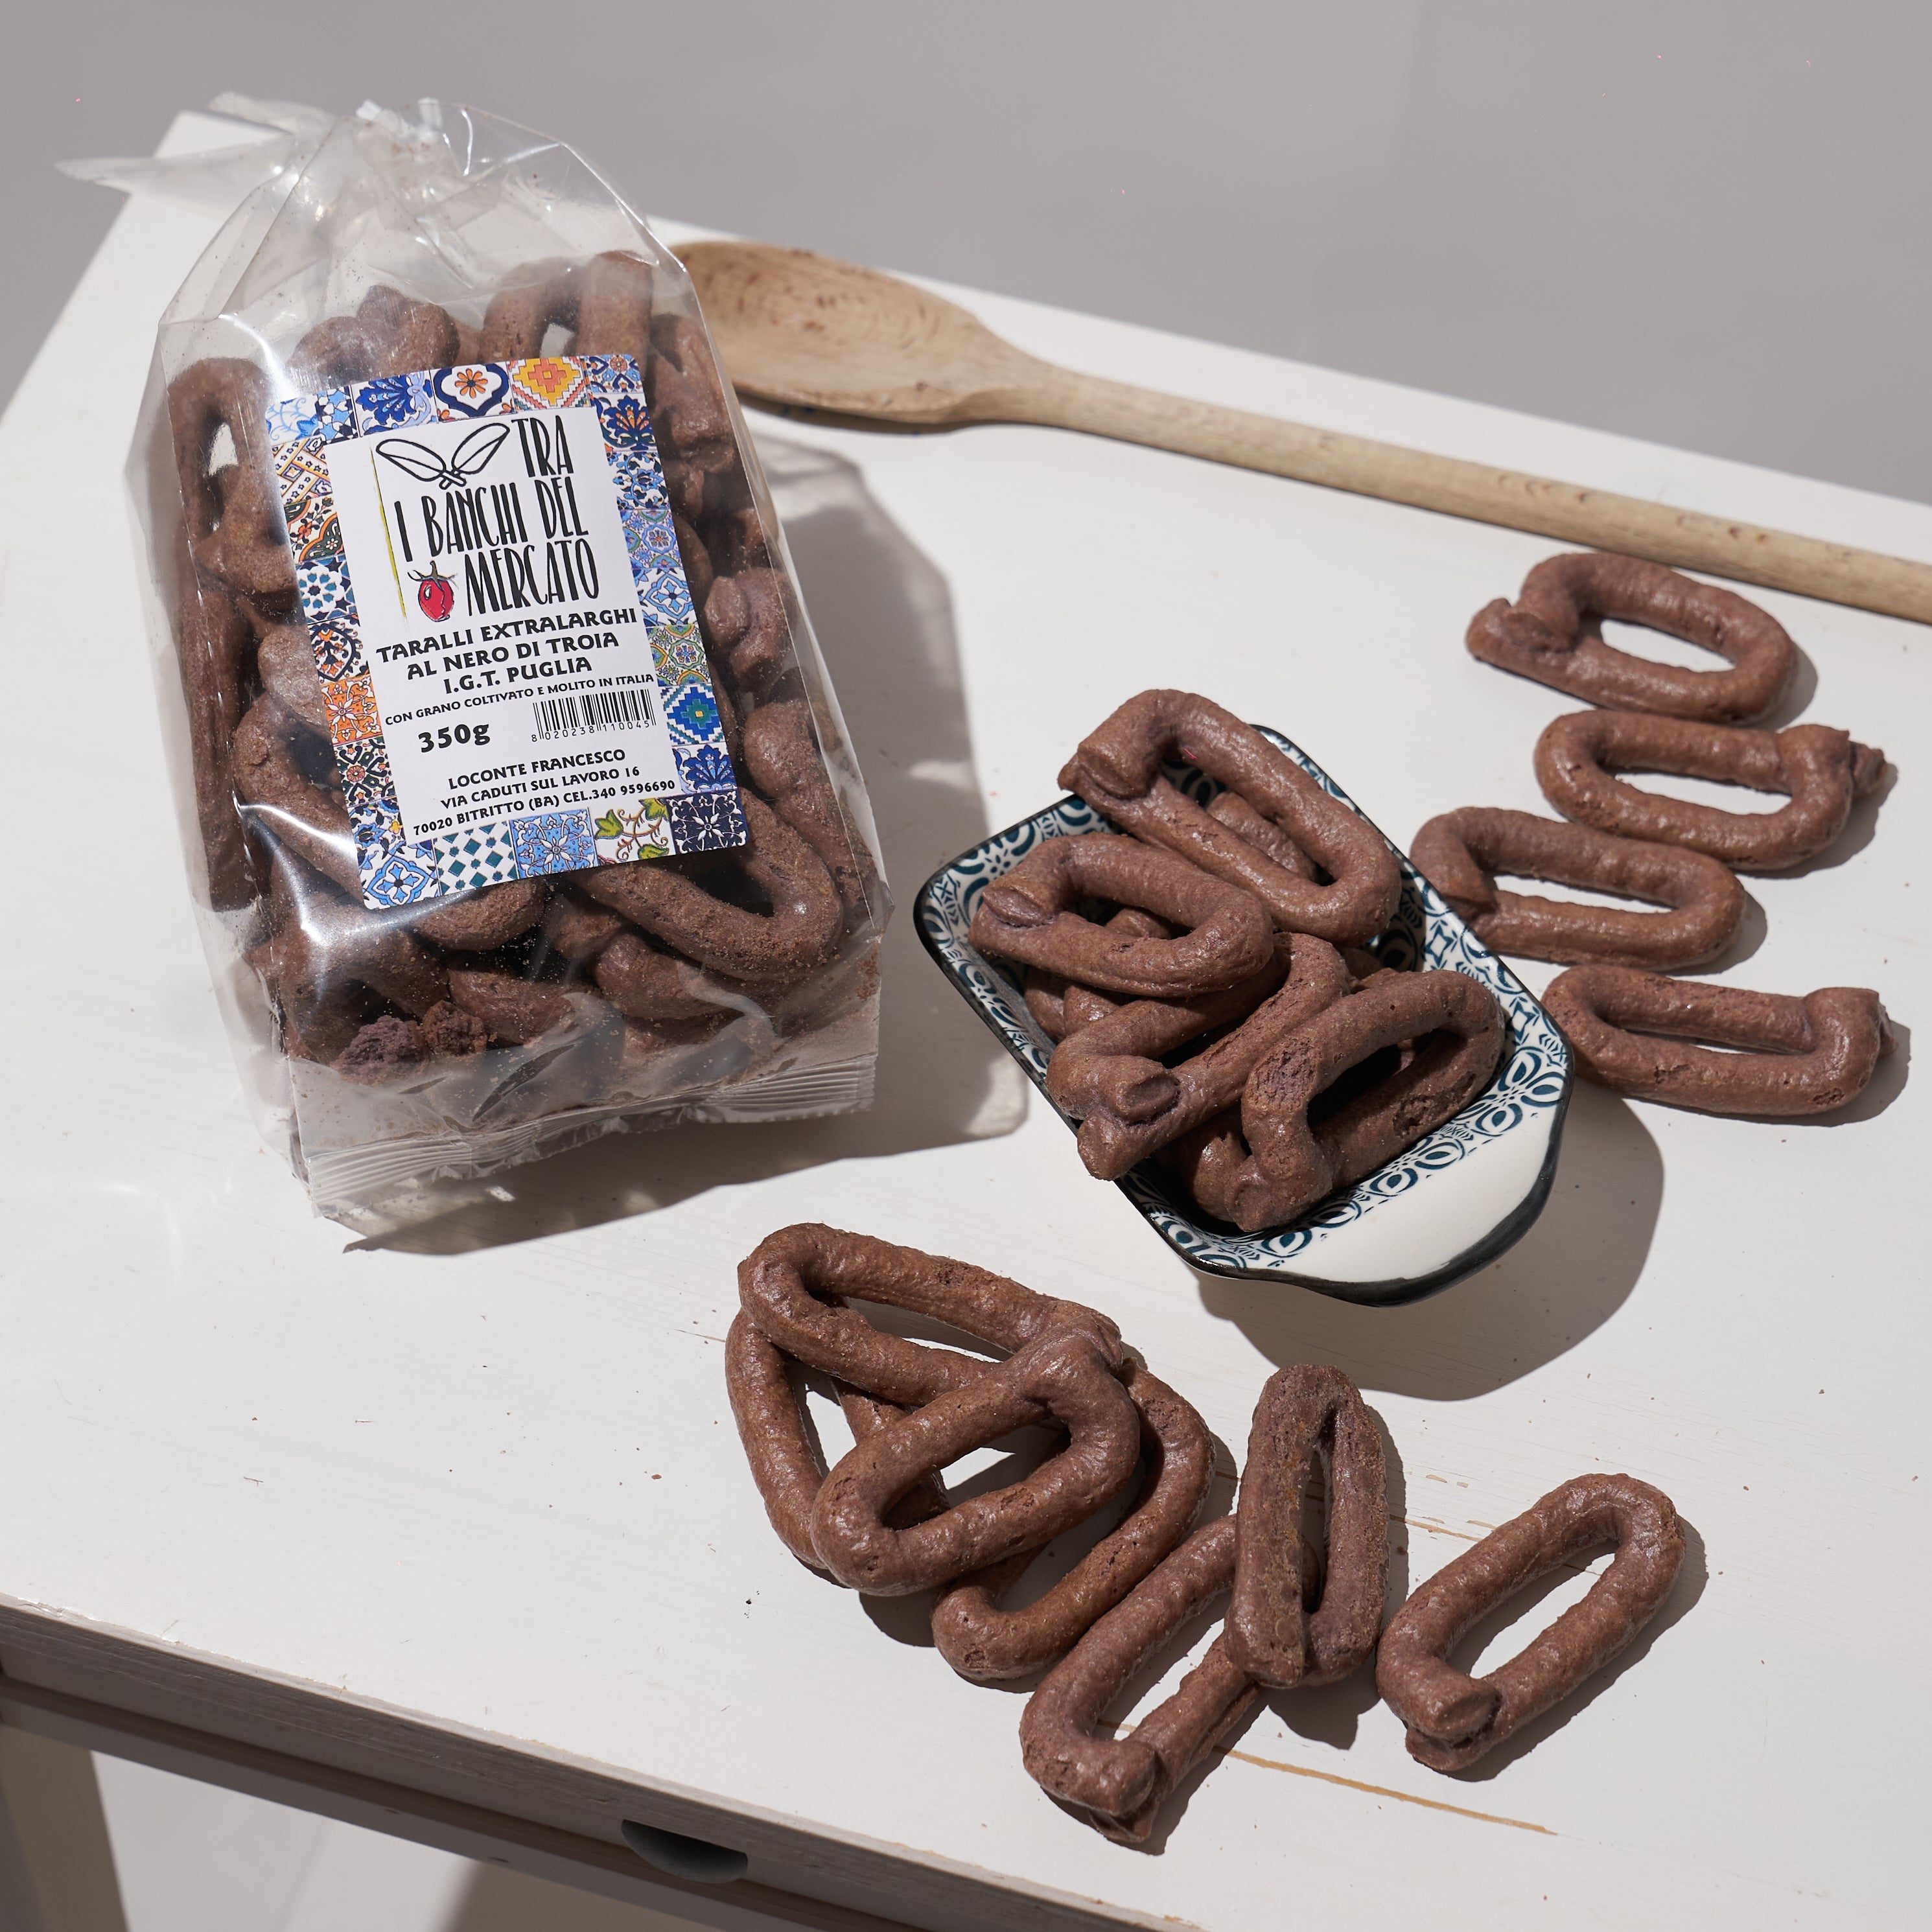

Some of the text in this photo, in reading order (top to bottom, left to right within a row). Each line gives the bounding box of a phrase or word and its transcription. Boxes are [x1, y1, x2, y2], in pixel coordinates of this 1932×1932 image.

[511, 415, 574, 478] TRA
[394, 476, 589, 563] I BANCHI DEL
[464, 538, 599, 616] MERCATO
[375, 608, 637, 663] TARALLI EXTRALARGHI
[407, 632, 619, 681] AL NERO DI TROIA
[385, 673, 655, 725] CON GRANO COLTIVATO E MOLITO IN ITALIA
[443, 657, 592, 694] I.G.T. PUGLIA
[418, 724, 491, 753] 350g
[440, 766, 640, 809] VIA CADUTI SUL LAVORO 16
[448, 749, 625, 790] LOCONTE FRANCESCO
[413, 780, 675, 836] 70020 BITRITTO (BA) CEL.340 9596690
